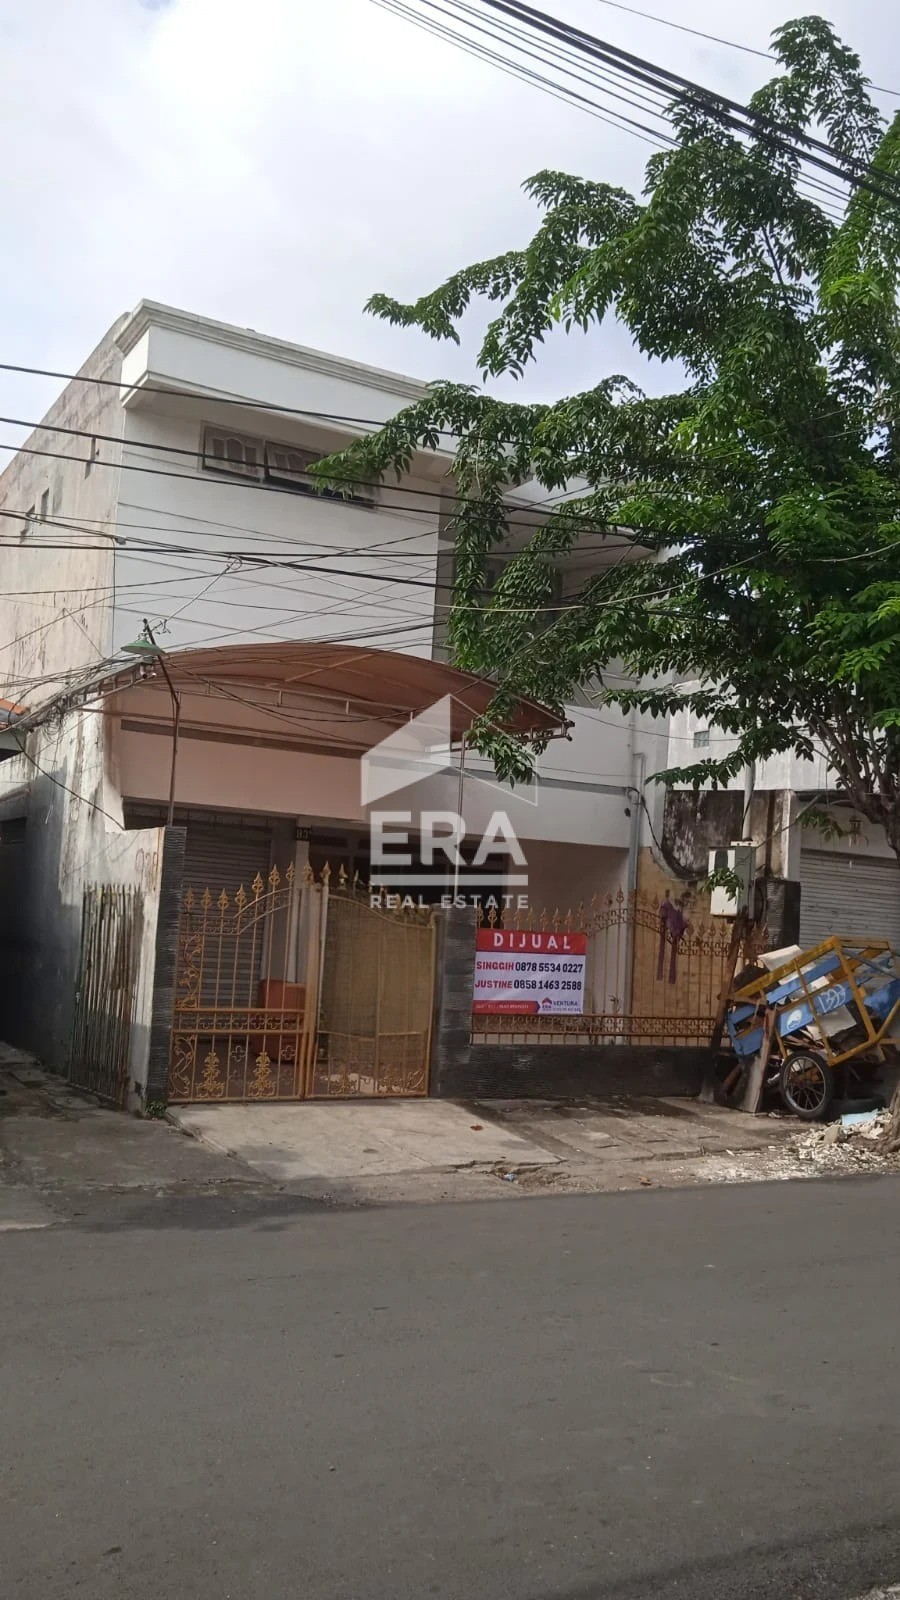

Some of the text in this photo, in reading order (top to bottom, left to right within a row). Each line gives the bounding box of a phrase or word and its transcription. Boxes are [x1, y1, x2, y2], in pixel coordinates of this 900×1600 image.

[494, 932, 570, 949] DIJUAL
[476, 961, 583, 973] SINGGIH 0878 5534 0227
[475, 979, 582, 991] JUSTINE 0858 1463 2588
